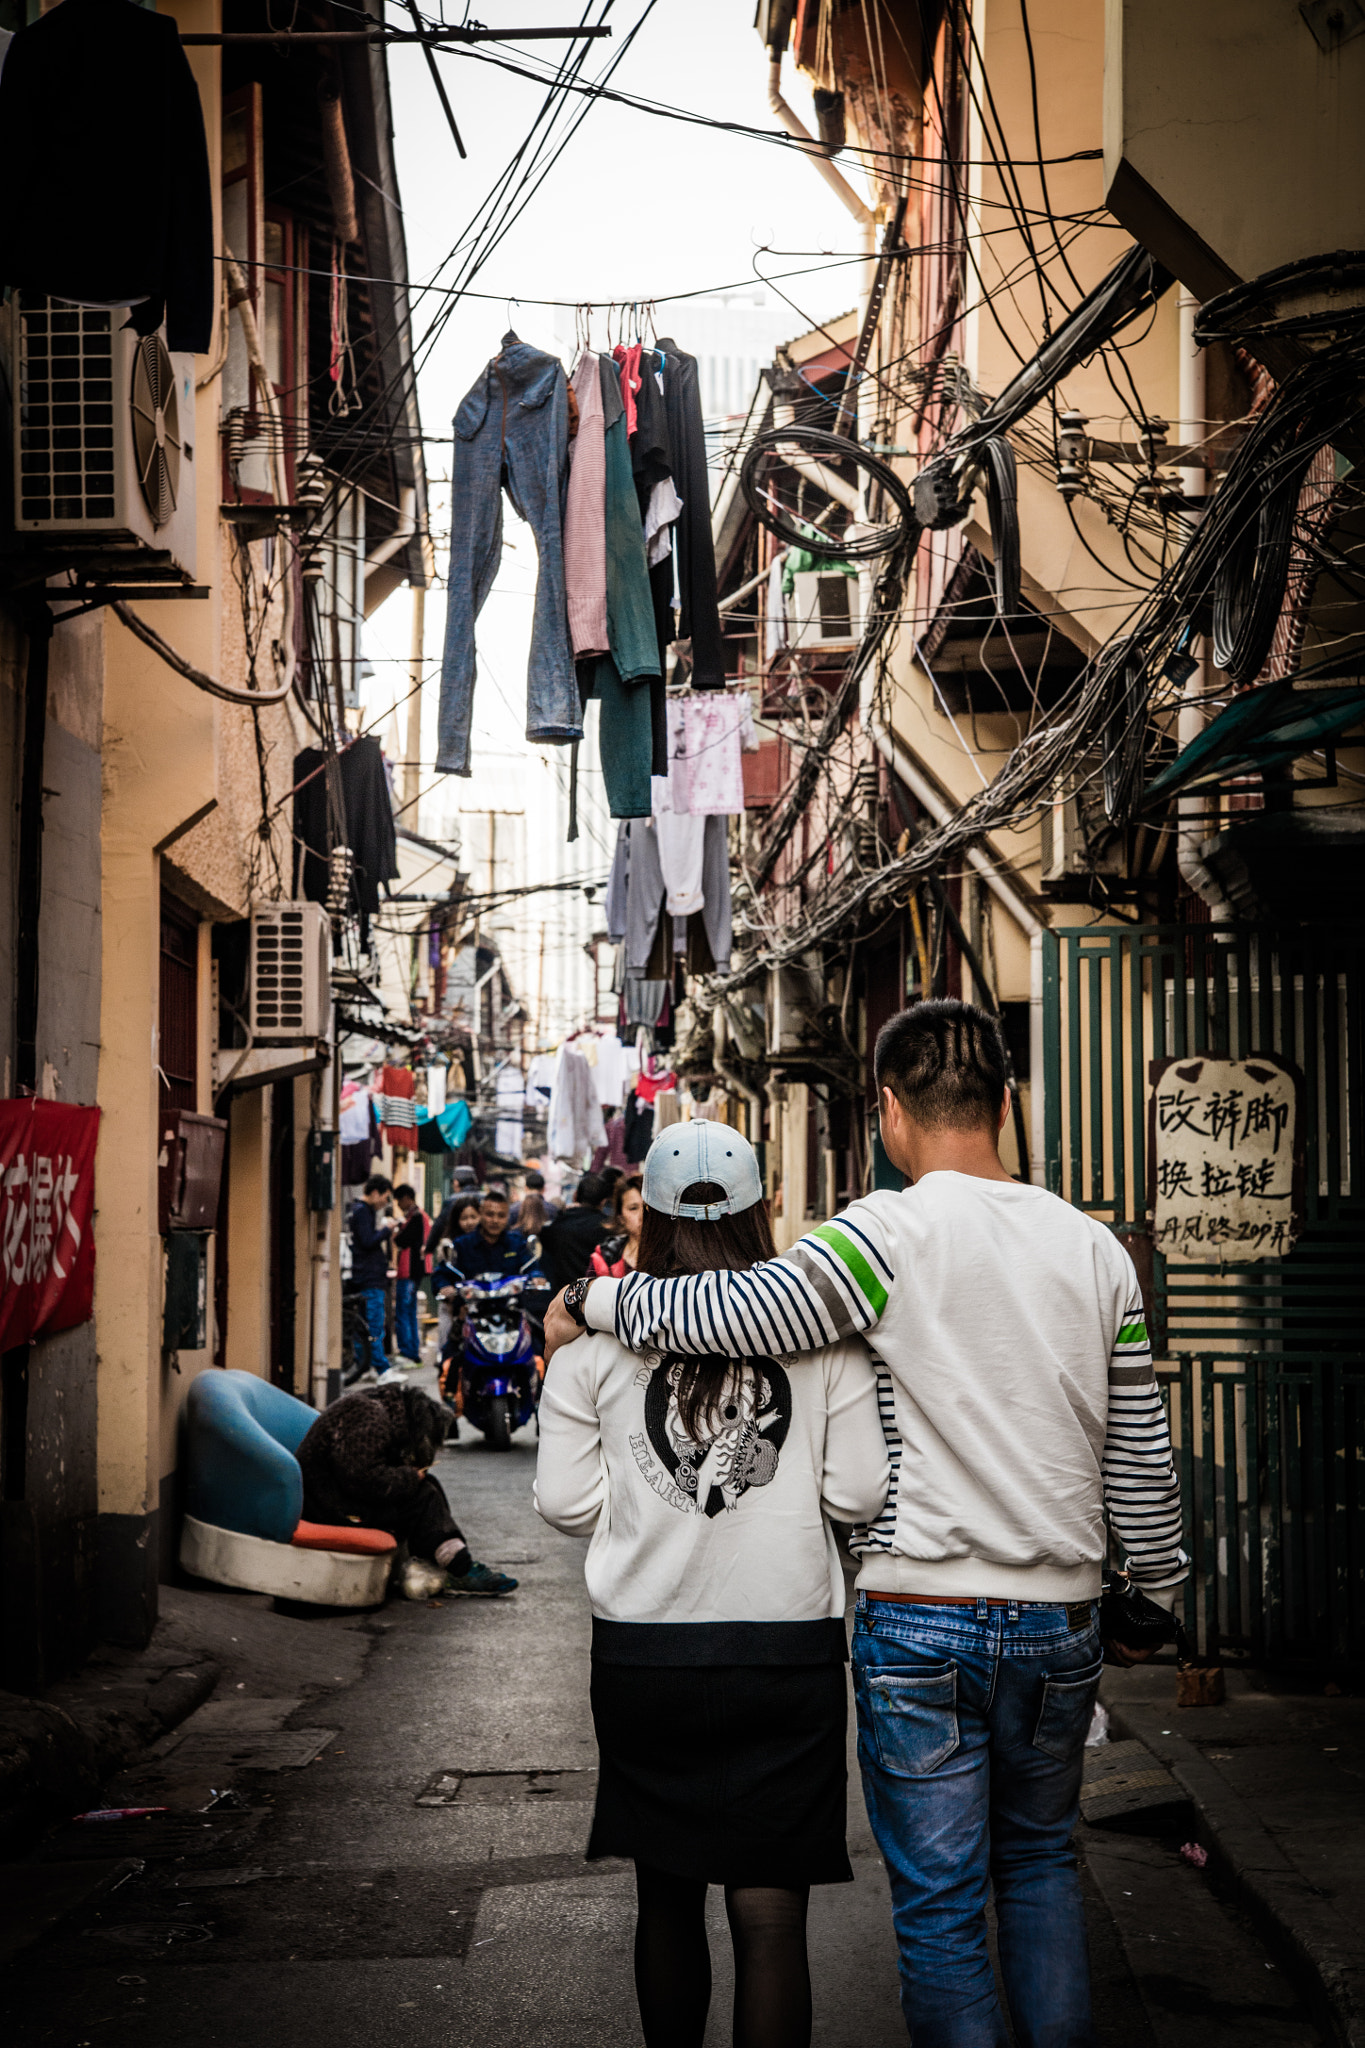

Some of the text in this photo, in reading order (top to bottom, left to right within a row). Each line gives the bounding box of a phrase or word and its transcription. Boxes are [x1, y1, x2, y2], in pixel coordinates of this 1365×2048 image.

[1158, 1089, 1290, 1155] 改裤脚
[1157, 1158, 1293, 1200] 换拉链
[629, 1432, 697, 1513] HEART
